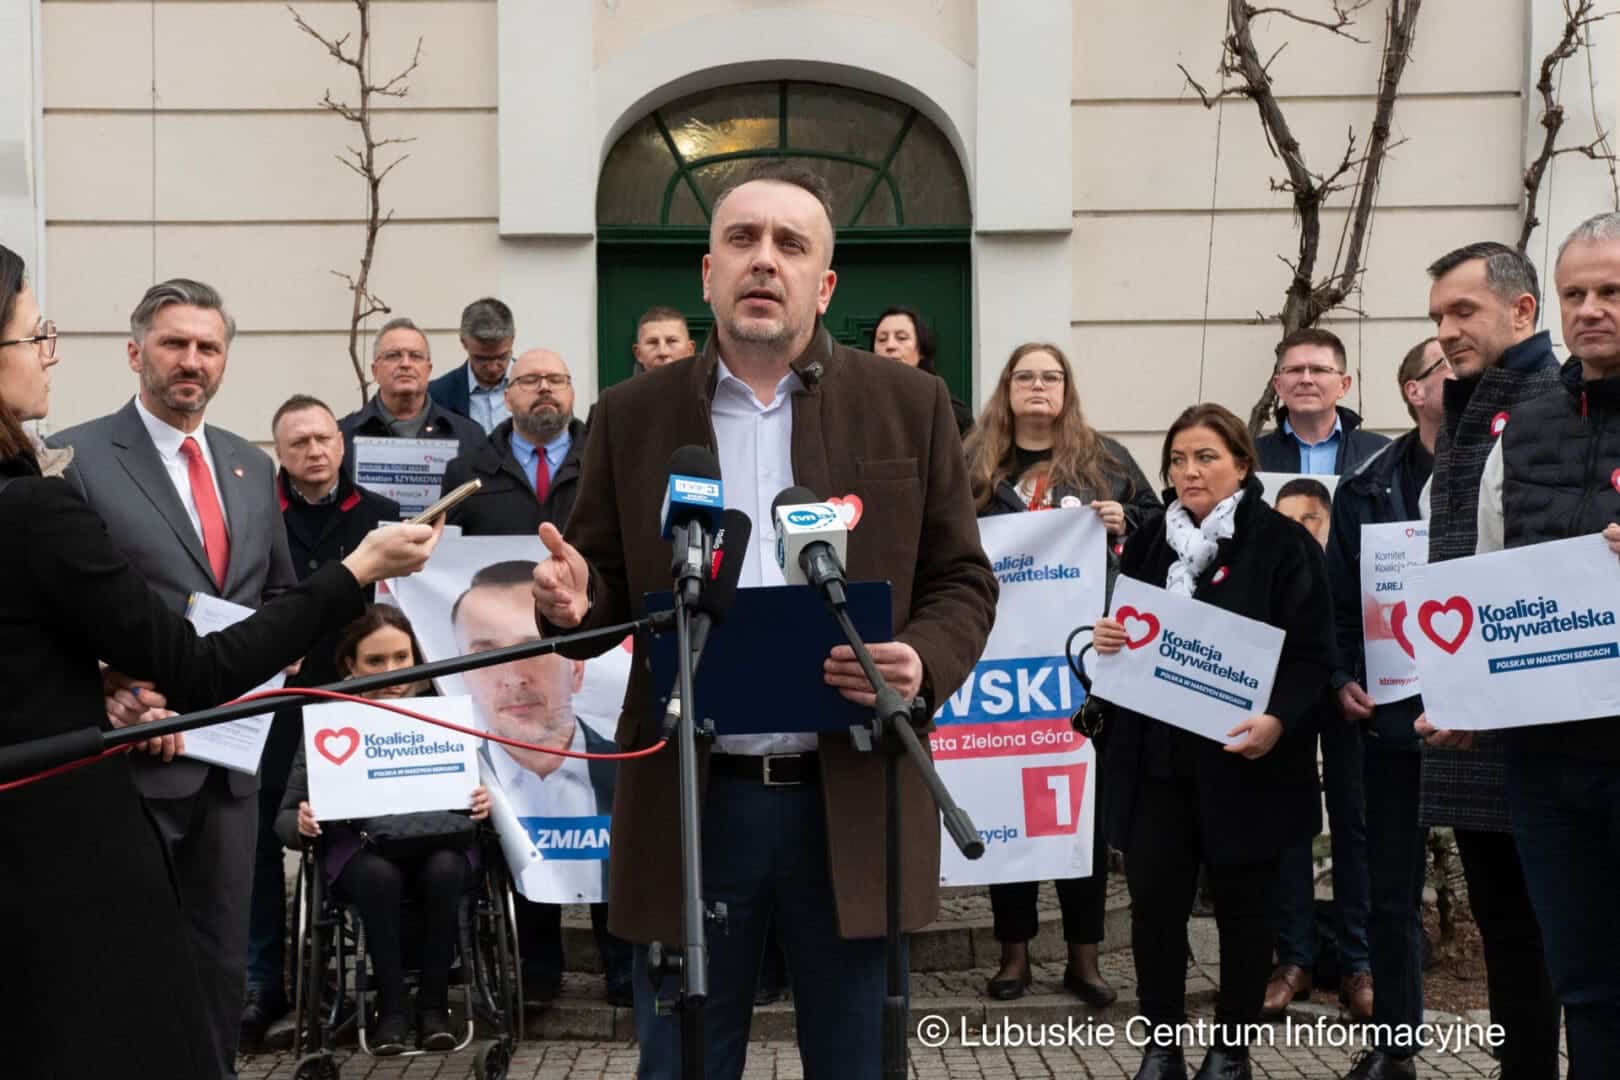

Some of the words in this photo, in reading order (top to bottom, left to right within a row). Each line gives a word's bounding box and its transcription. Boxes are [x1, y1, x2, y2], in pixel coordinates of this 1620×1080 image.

[993, 554, 1034, 572] alicja
[1375, 551, 1406, 561] Komitet
[998, 563, 1080, 584] watelska
[1375, 581, 1404, 592] ZAREJ
[1478, 596, 1558, 624] Koalicja
[1481, 608, 1616, 643] Obywatelska
[1162, 629, 1222, 662] Koalicja
[1159, 643, 1259, 689] Obywatelska
[1496, 658, 1527, 670] POLSKA
[1527, 657, 1536, 666] W
[1536, 652, 1573, 665] NASZYCH
[1574, 647, 1611, 660] SERCACH
[933, 665, 1072, 718] WSKI
[364, 731, 424, 747] Koalicja
[930, 736, 957, 751] sta
[962, 732, 1026, 750] Zielona
[1031, 728, 1074, 745] Góra
[365, 742, 464, 760] Obywatelska
[1047, 775, 1072, 825] 1
[536, 828, 611, 849] ZMIAN
[978, 825, 1017, 844] zycja
